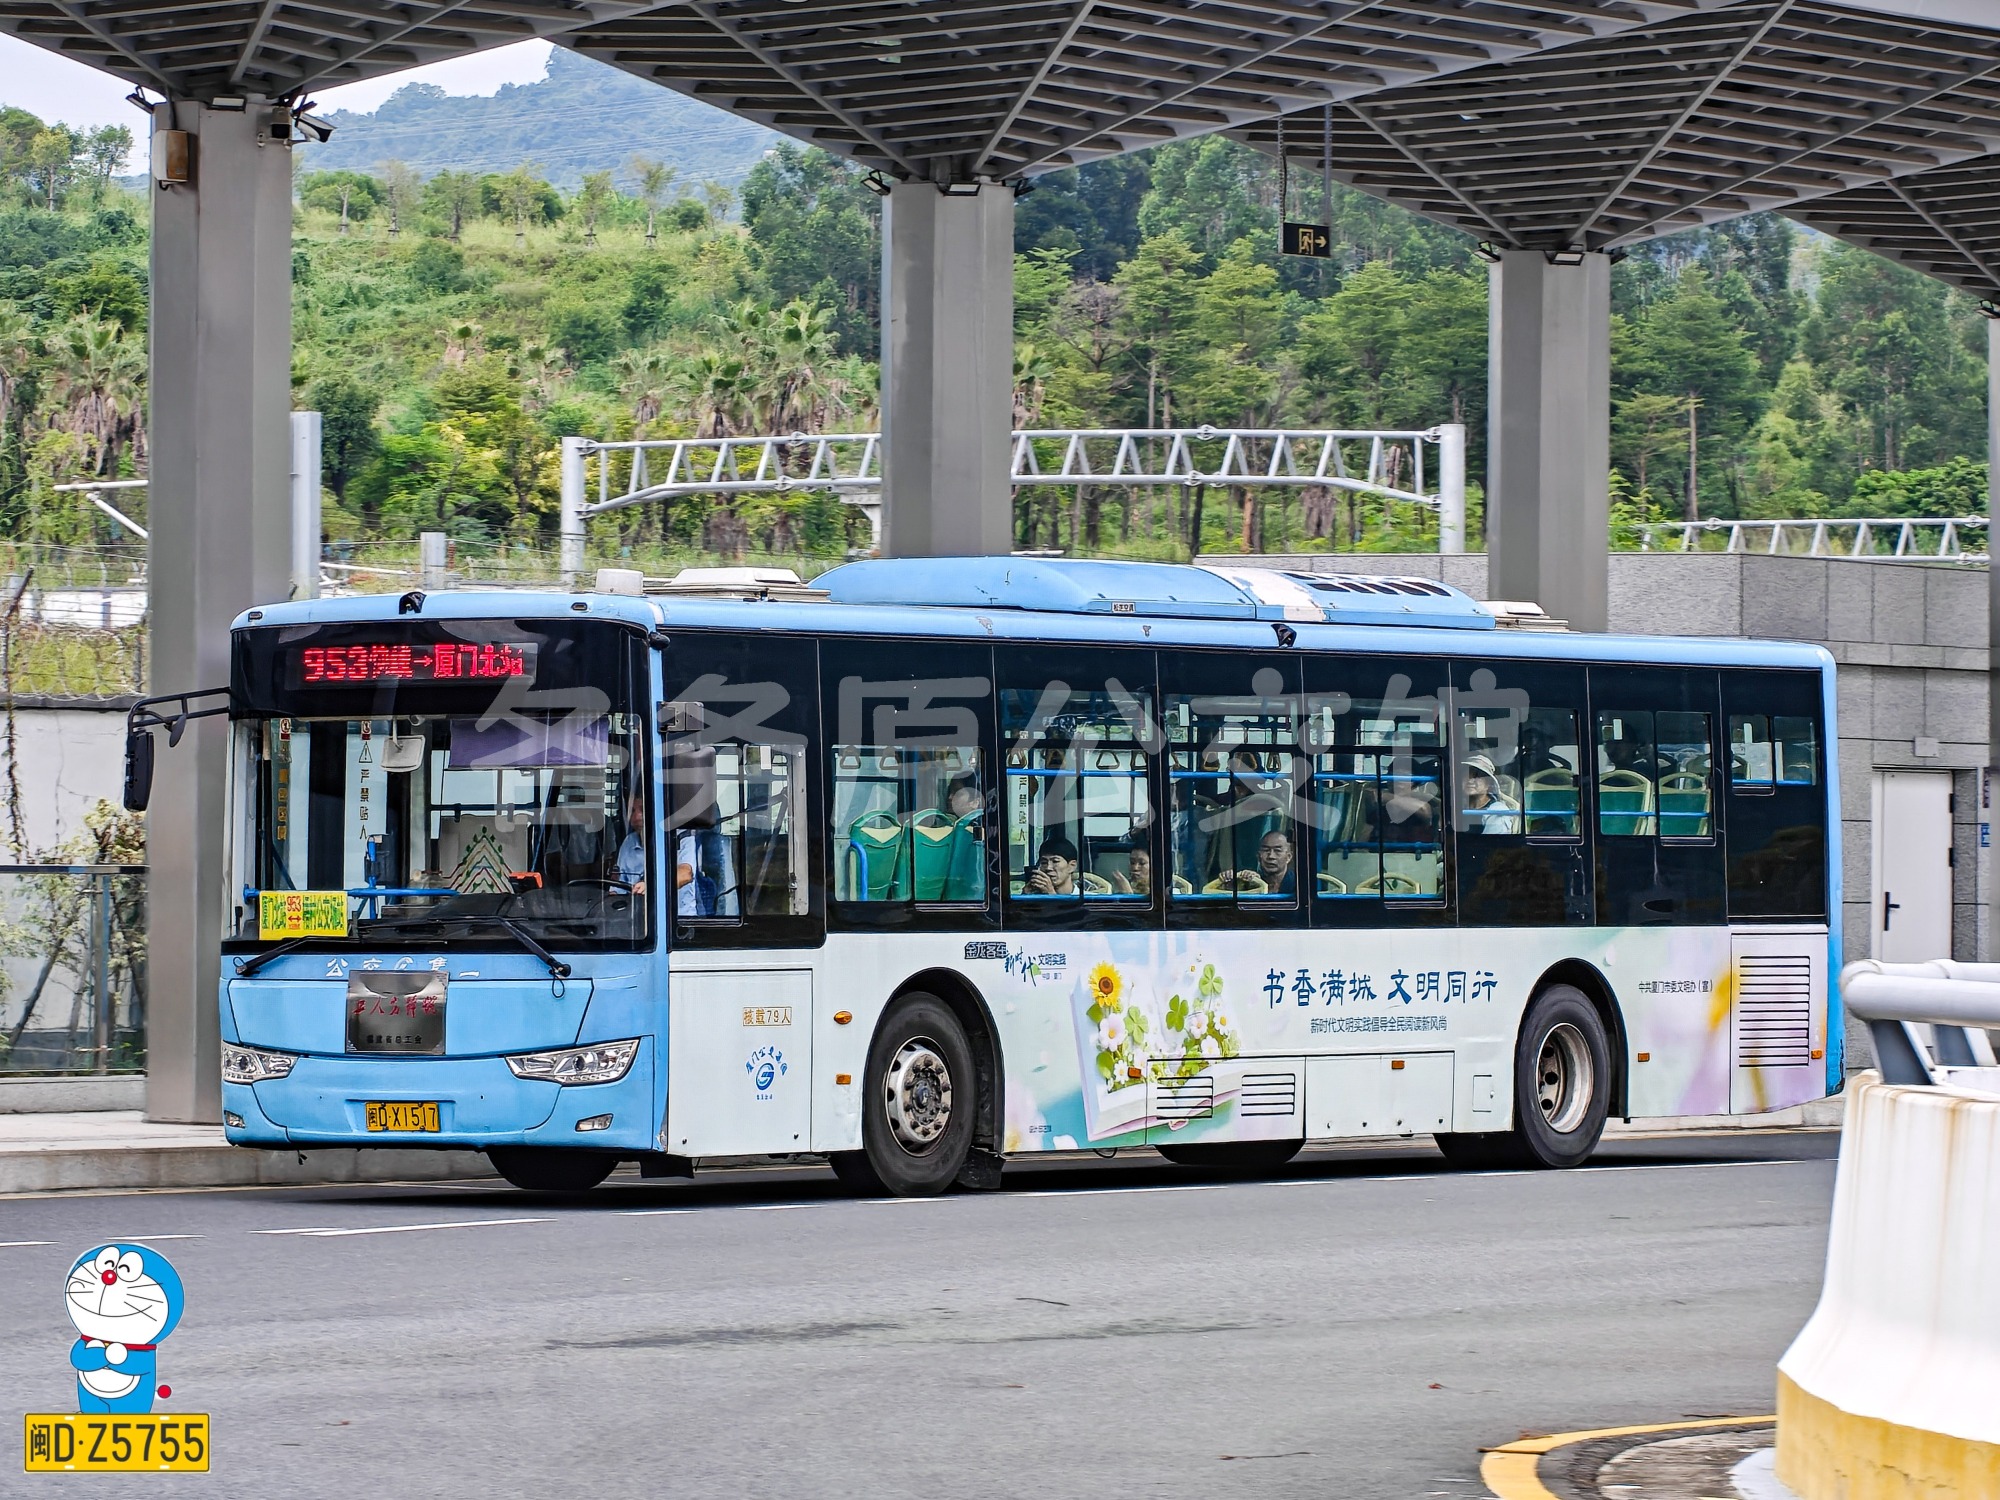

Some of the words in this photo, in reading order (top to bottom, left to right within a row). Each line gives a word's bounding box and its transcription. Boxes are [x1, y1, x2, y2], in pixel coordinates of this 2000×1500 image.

[1263, 968, 1378, 1009] 书香满城
[1387, 969, 1499, 1005] 文明同行
[1310, 1015, 1448, 1034] 新时代文明实践倡导全民阅读新风尚
[368, 1106, 436, 1127] 闽D·X1517
